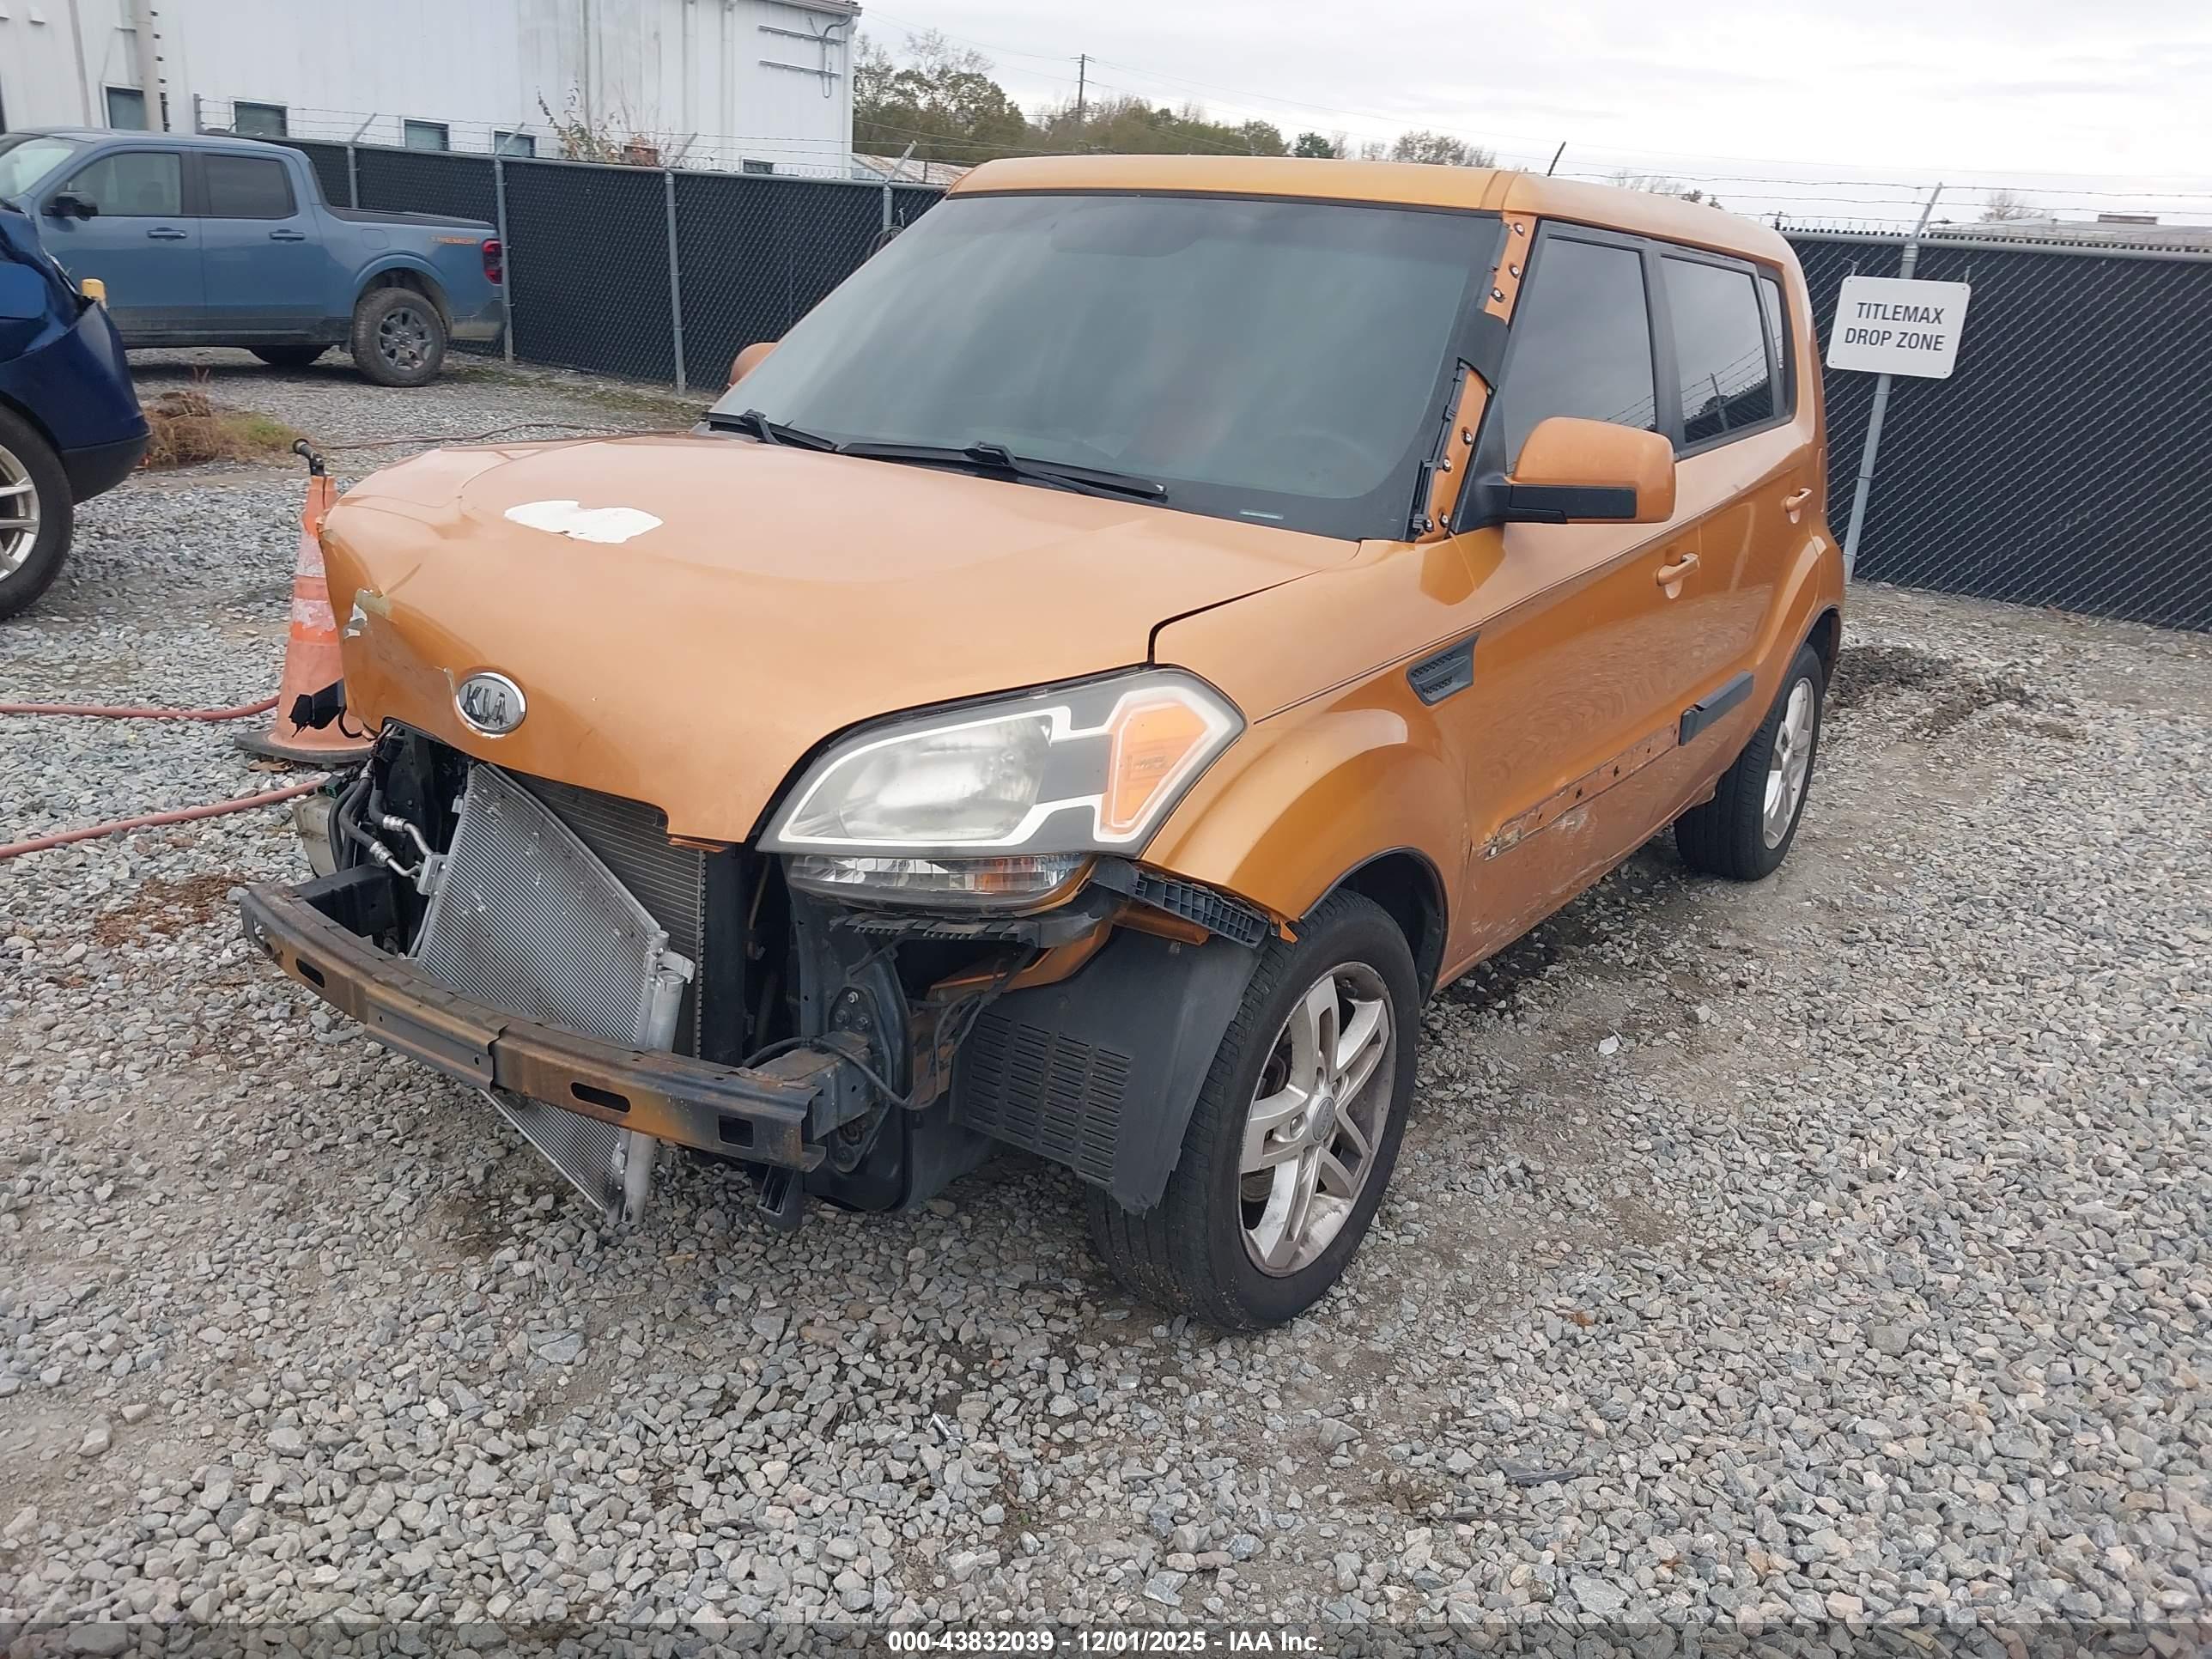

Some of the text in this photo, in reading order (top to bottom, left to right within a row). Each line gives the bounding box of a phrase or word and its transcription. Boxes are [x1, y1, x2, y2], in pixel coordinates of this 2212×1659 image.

[1856, 302, 1945, 325] TITLEMAX
[1844, 327, 1945, 351] DROP ZONE
[463, 684, 510, 726] KIA
